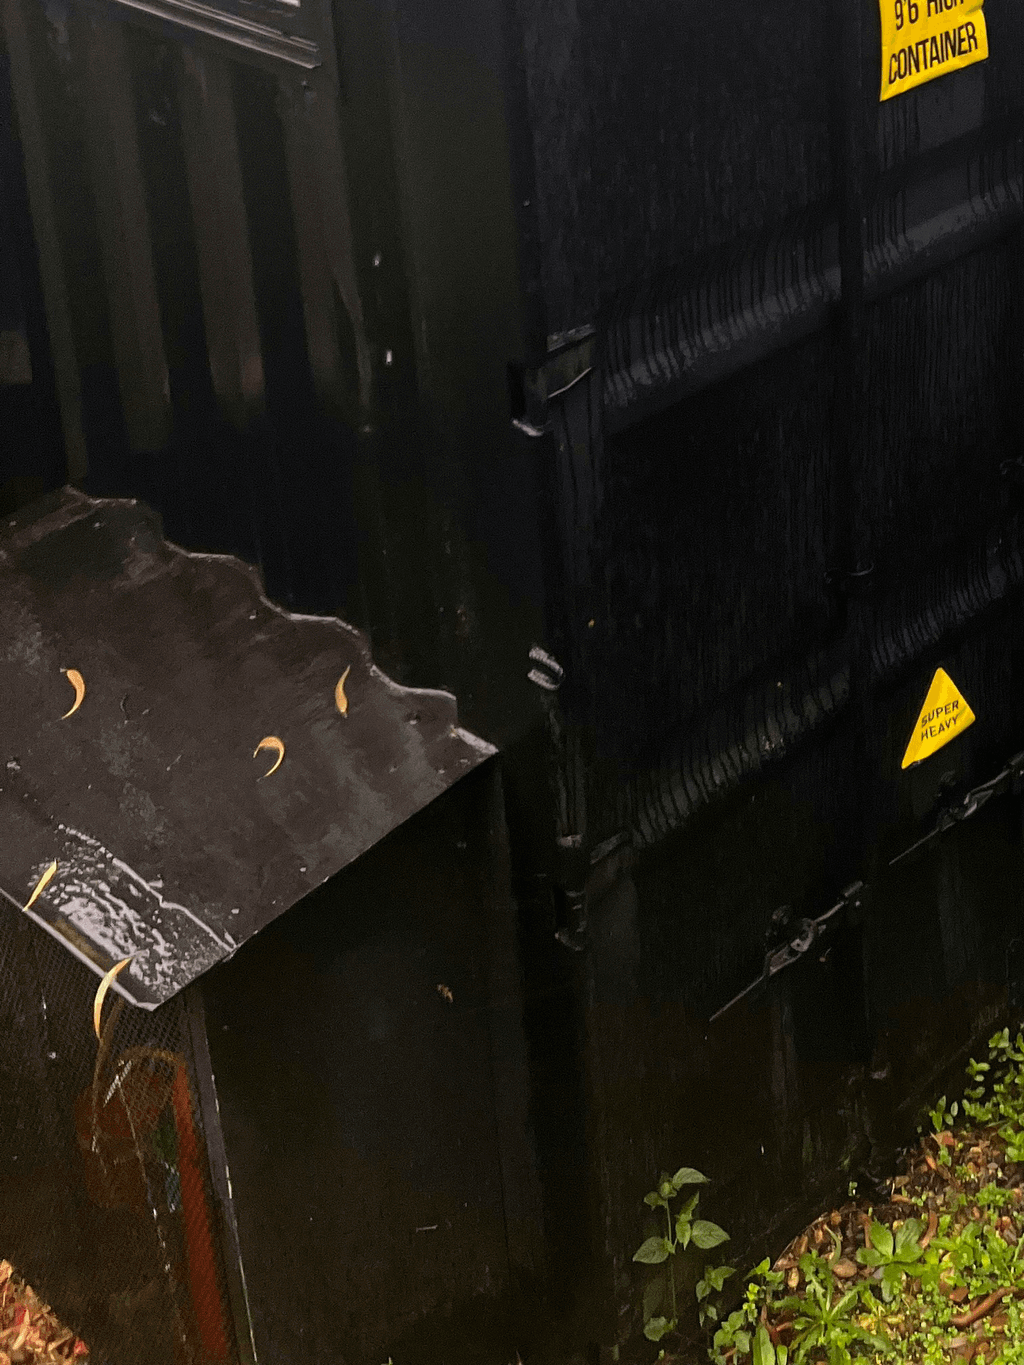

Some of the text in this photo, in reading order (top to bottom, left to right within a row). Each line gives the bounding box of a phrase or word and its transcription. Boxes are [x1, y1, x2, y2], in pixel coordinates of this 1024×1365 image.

[887, 20, 979, 86] CONTAINER
[920, 714, 960, 742] HEAVY
[921, 699, 960, 729] SUPER
